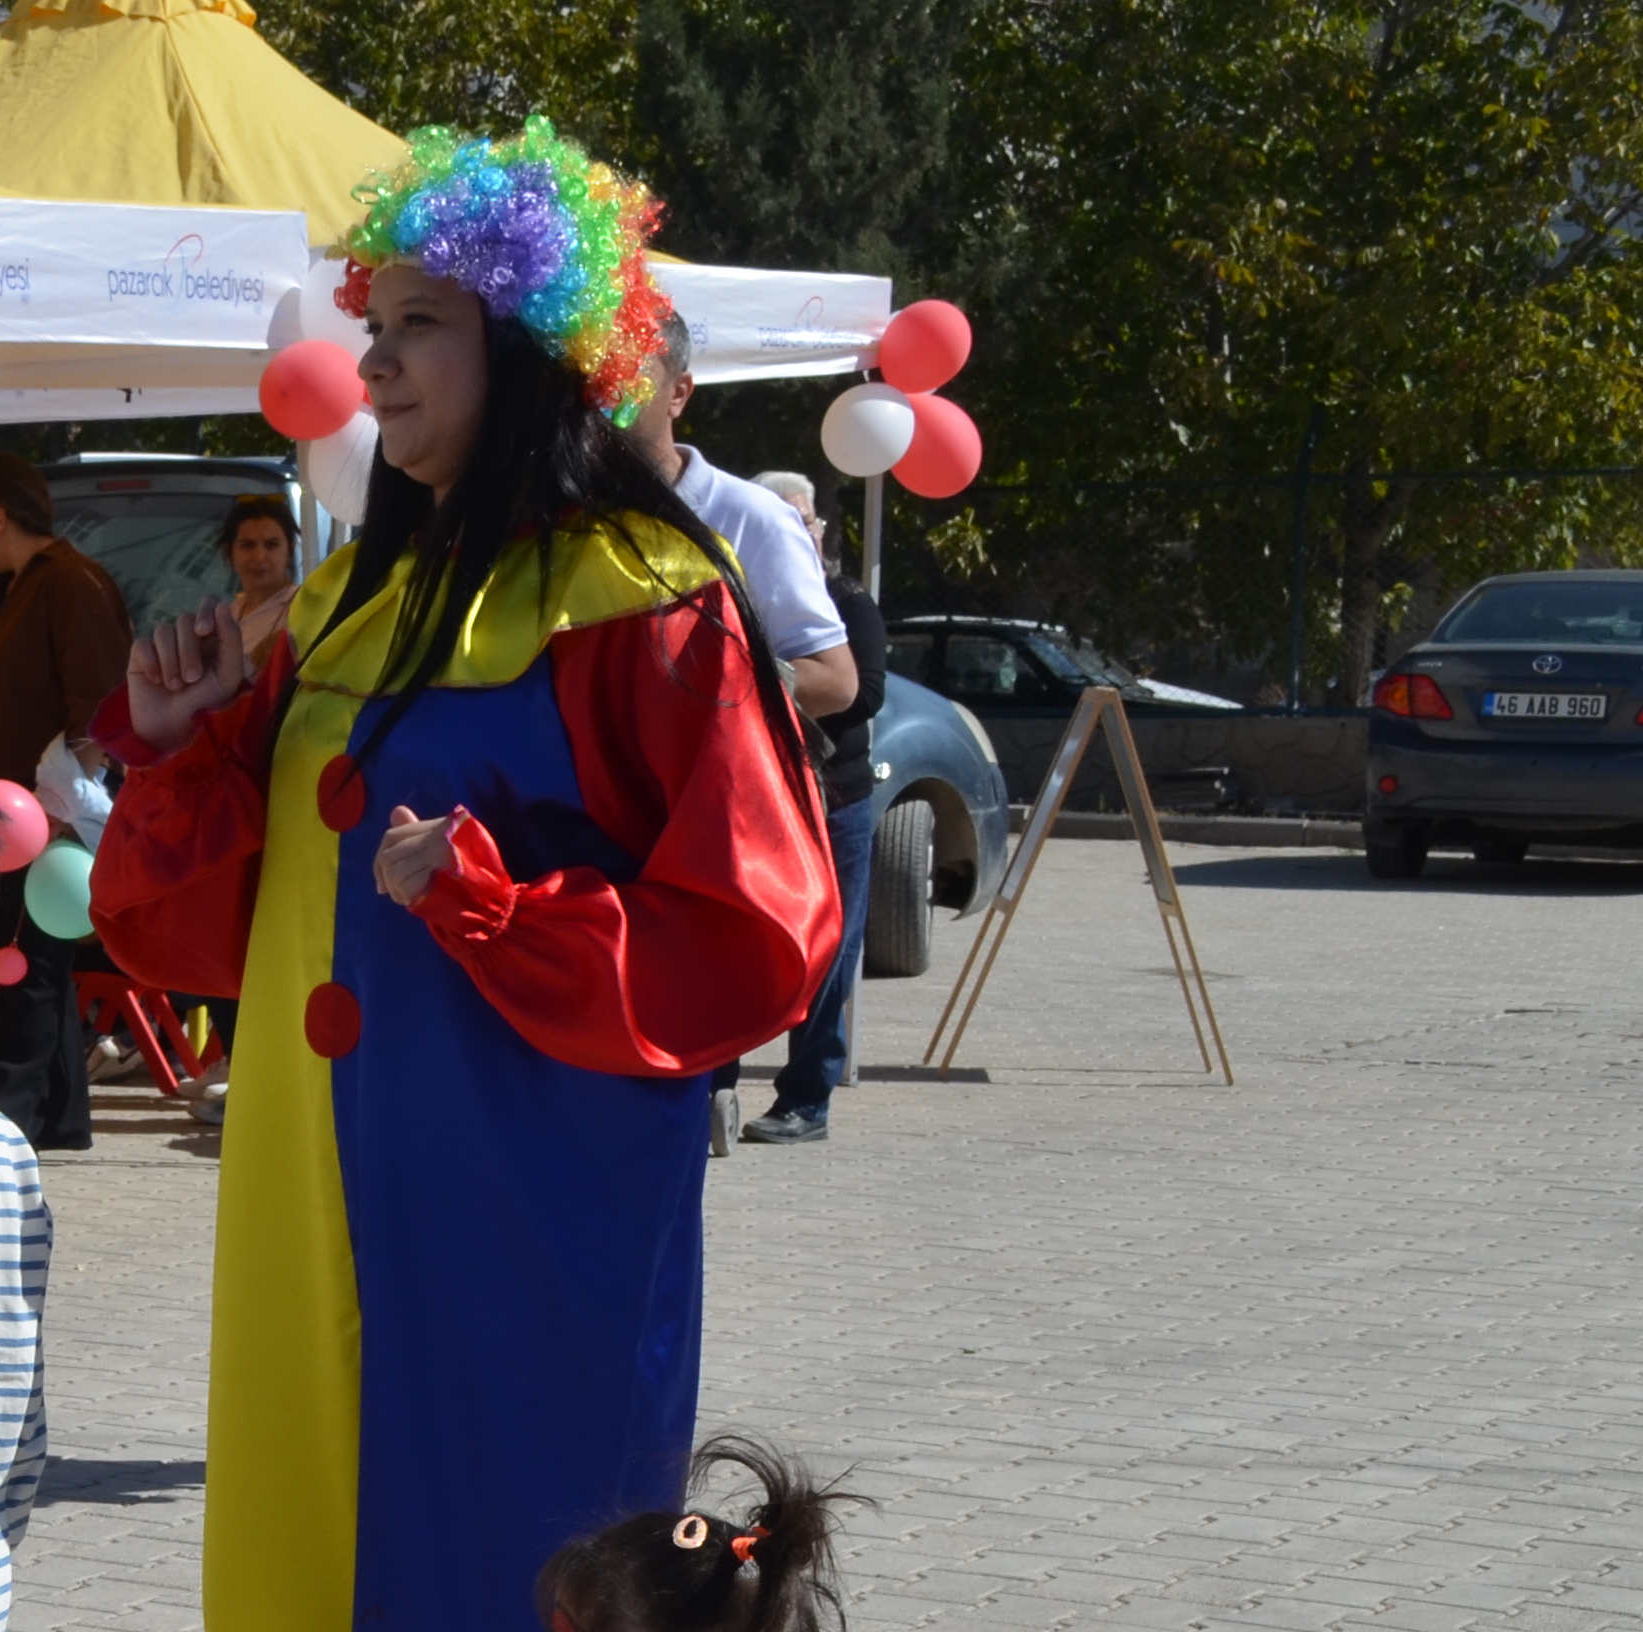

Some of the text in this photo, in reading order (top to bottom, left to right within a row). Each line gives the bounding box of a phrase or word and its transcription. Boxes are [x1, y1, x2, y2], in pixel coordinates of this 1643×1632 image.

[107, 264, 265, 308] pazarcık belediyesi
[1496, 696, 1601, 716] 46 AAB 960
